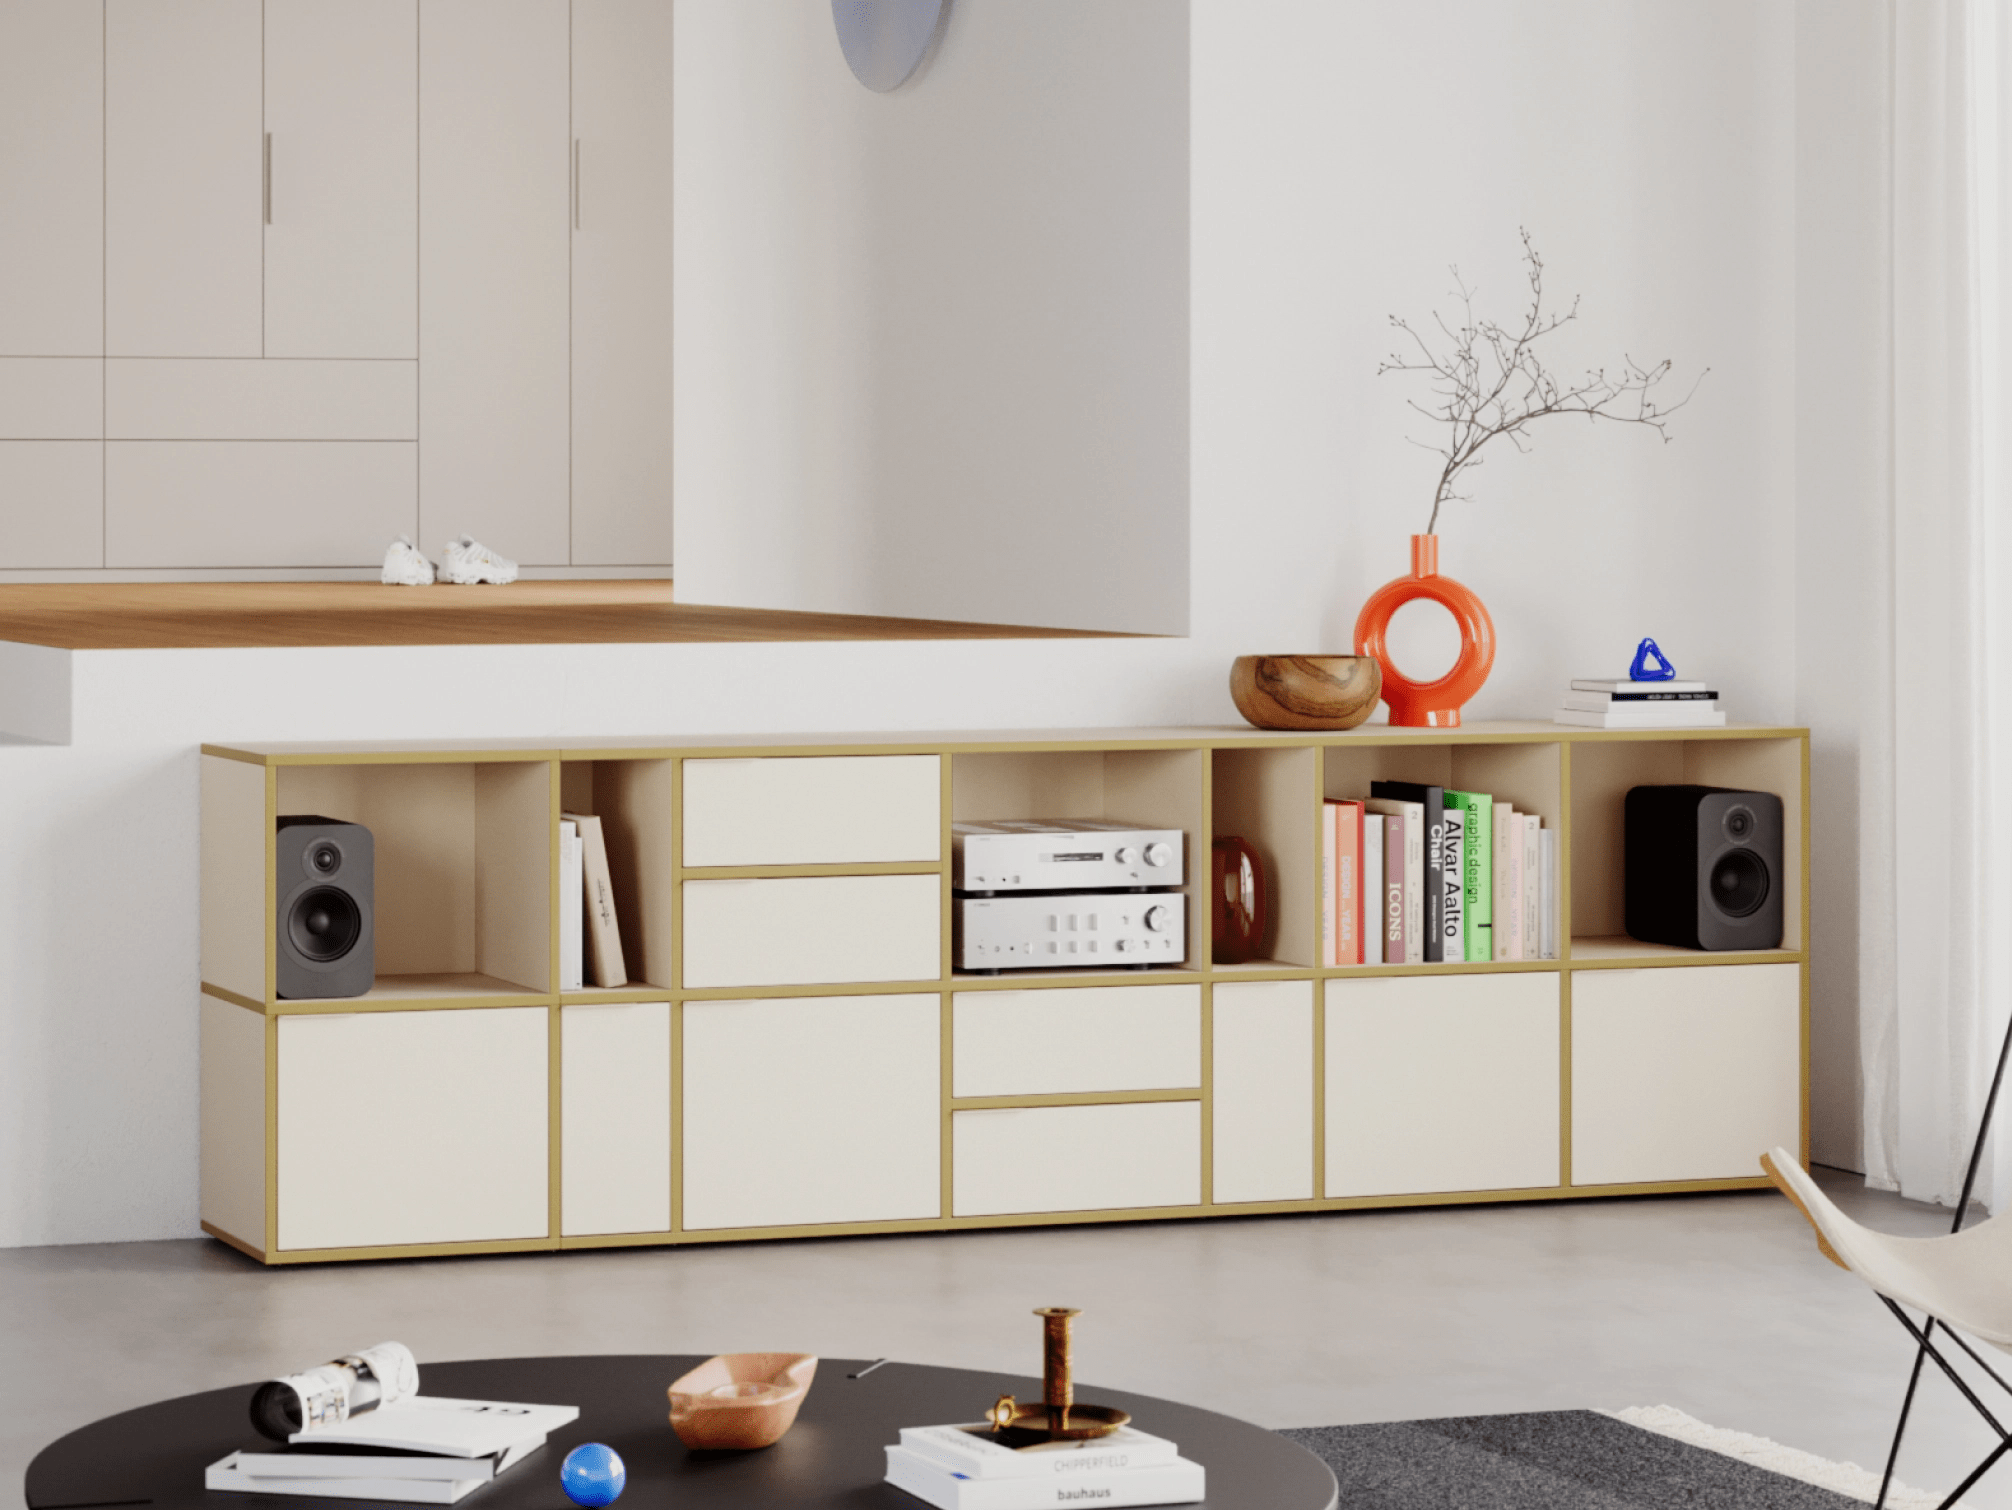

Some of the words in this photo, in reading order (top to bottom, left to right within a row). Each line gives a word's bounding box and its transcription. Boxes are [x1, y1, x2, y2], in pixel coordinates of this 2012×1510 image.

[1430, 824, 1443, 872] Chair
[1444, 819, 1461, 876] Alvar
[1467, 803, 1481, 856] graphic
[1467, 858, 1481, 904] design
[1389, 882, 1402, 942] ICONS
[1444, 881, 1461, 937] Aalto
[1057, 1486, 1111, 1500] bauhaus
